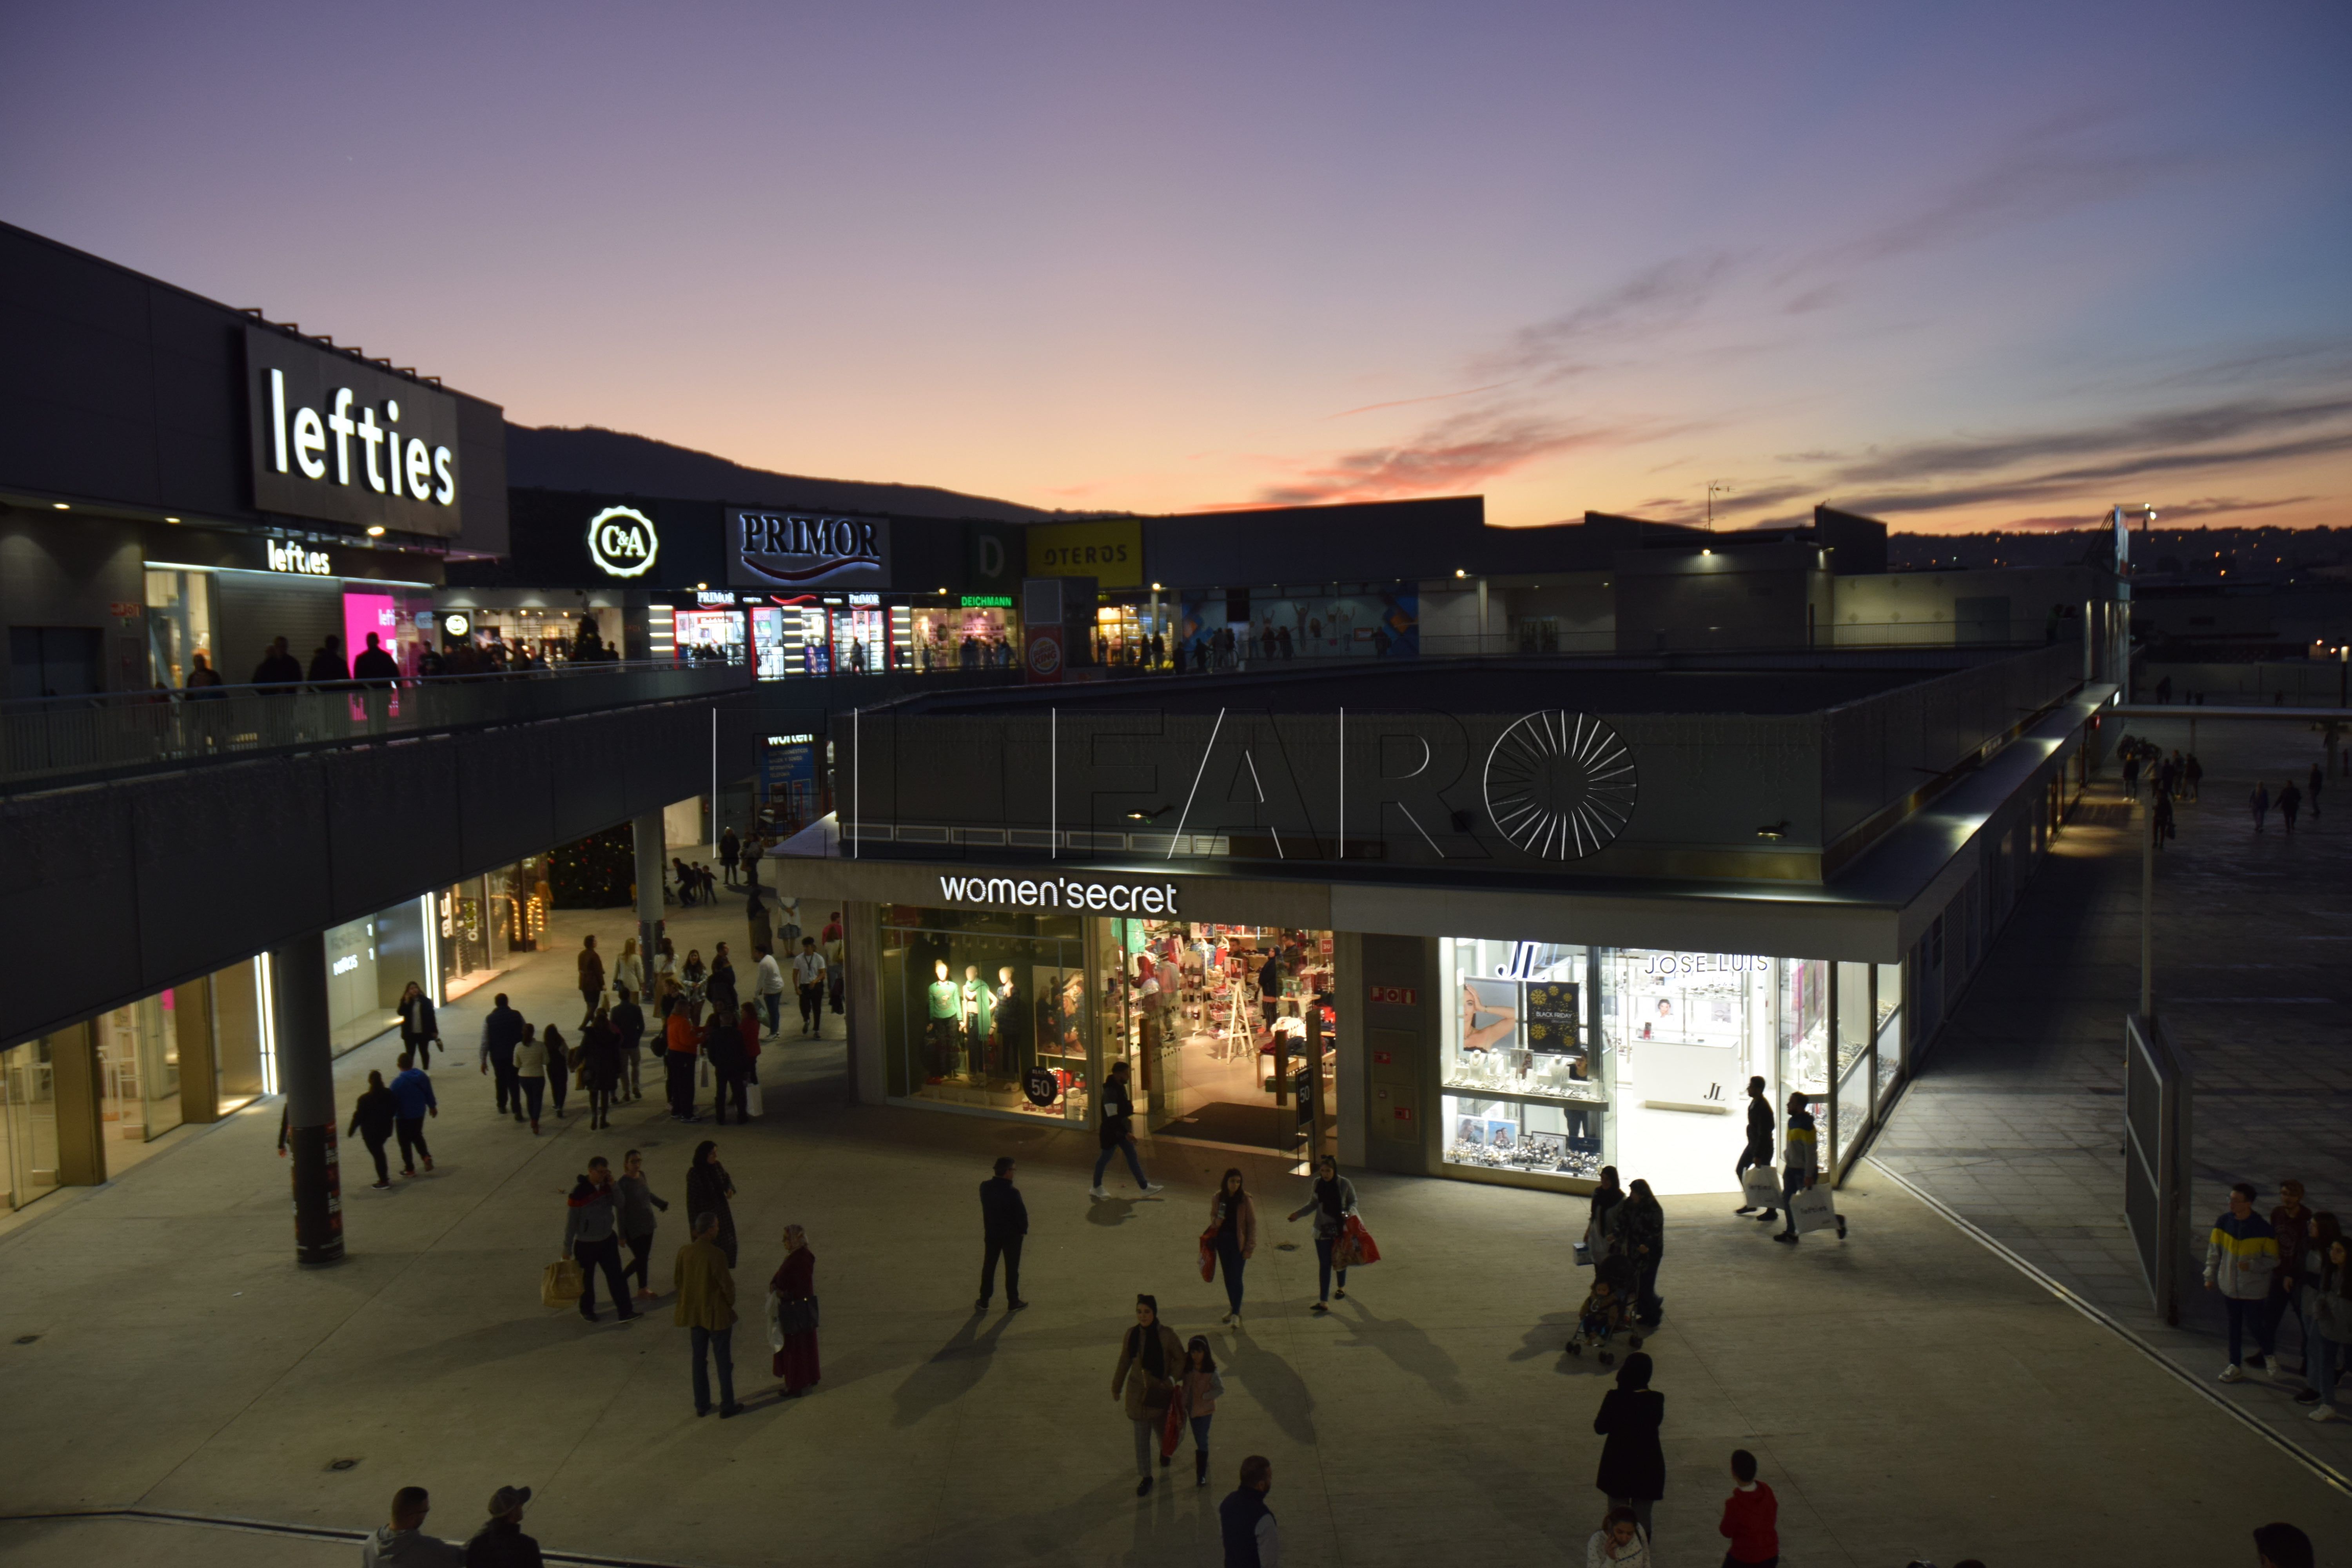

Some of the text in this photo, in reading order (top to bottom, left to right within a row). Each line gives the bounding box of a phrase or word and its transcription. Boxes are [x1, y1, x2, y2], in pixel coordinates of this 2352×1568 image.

[271, 368, 455, 506] lefties
[601, 525, 646, 556] C&A
[740, 514, 881, 557] PRIMOR
[267, 539, 330, 575] lefties
[1044, 544, 1127, 566] OTEROS
[697, 592, 735, 603] PRIMOR
[848, 594, 879, 604] PRIMOR
[961, 596, 1012, 607] DEICHMANN
[1034, 650, 1057, 665] KING
[940, 877, 1178, 914] women'secret
[1644, 953, 1769, 974] JOSE LUIS
[1031, 1079, 1050, 1097] 50
[1300, 1085, 1310, 1103] 50
[1703, 1082, 1726, 1101] JL
